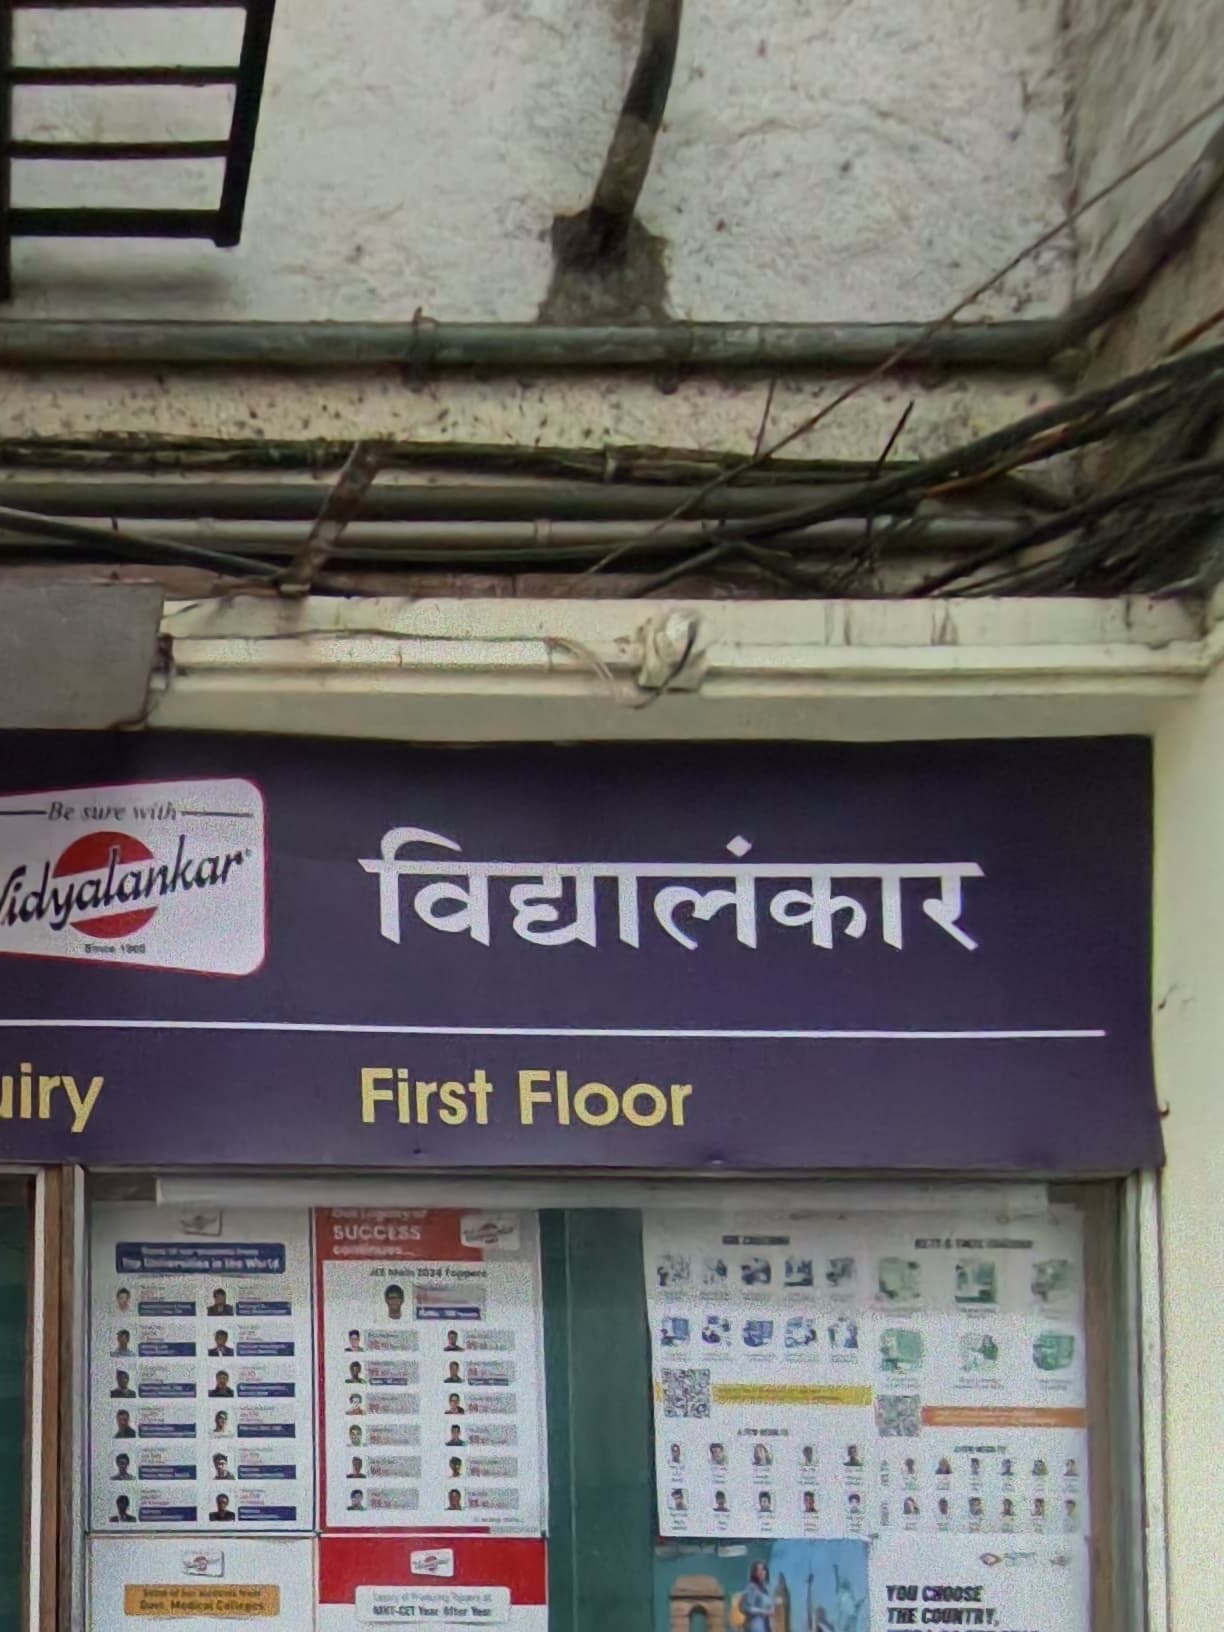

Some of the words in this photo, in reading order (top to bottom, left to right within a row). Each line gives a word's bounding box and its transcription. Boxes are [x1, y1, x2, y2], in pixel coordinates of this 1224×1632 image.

[48, 801, 71, 821] Be
[80, 805, 126, 821] sure
[133, 800, 177, 821] with
[358, 827, 985, 950] विद्यालंकार
[360, 1067, 493, 1125] First
[517, 1069, 693, 1127] Floor
[333, 1225, 422, 1241] SUCCESS
[886, 1585, 918, 1602] YOU
[922, 1585, 984, 1602] CHOOSE
[887, 1607, 918, 1625] THE
